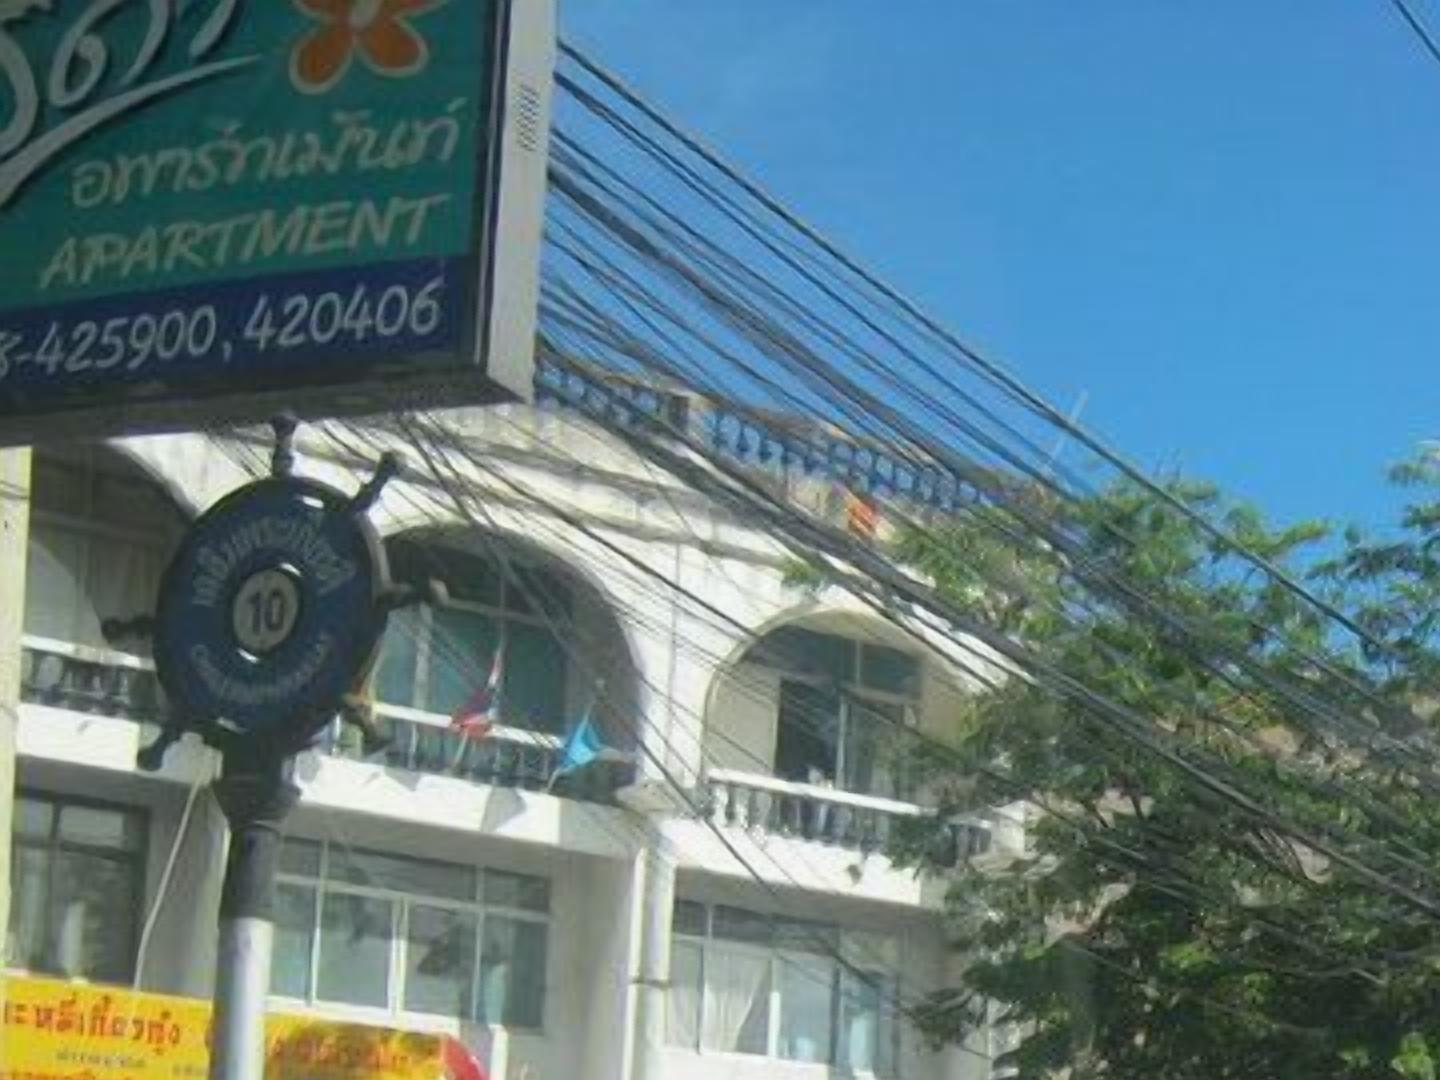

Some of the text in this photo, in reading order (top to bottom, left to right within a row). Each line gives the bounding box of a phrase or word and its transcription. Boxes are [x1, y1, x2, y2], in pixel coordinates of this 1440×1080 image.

[40, 195, 450, 289] APARTMENT
[243, 276, 445, 353] 420406
[250, 587, 287, 634] 10
